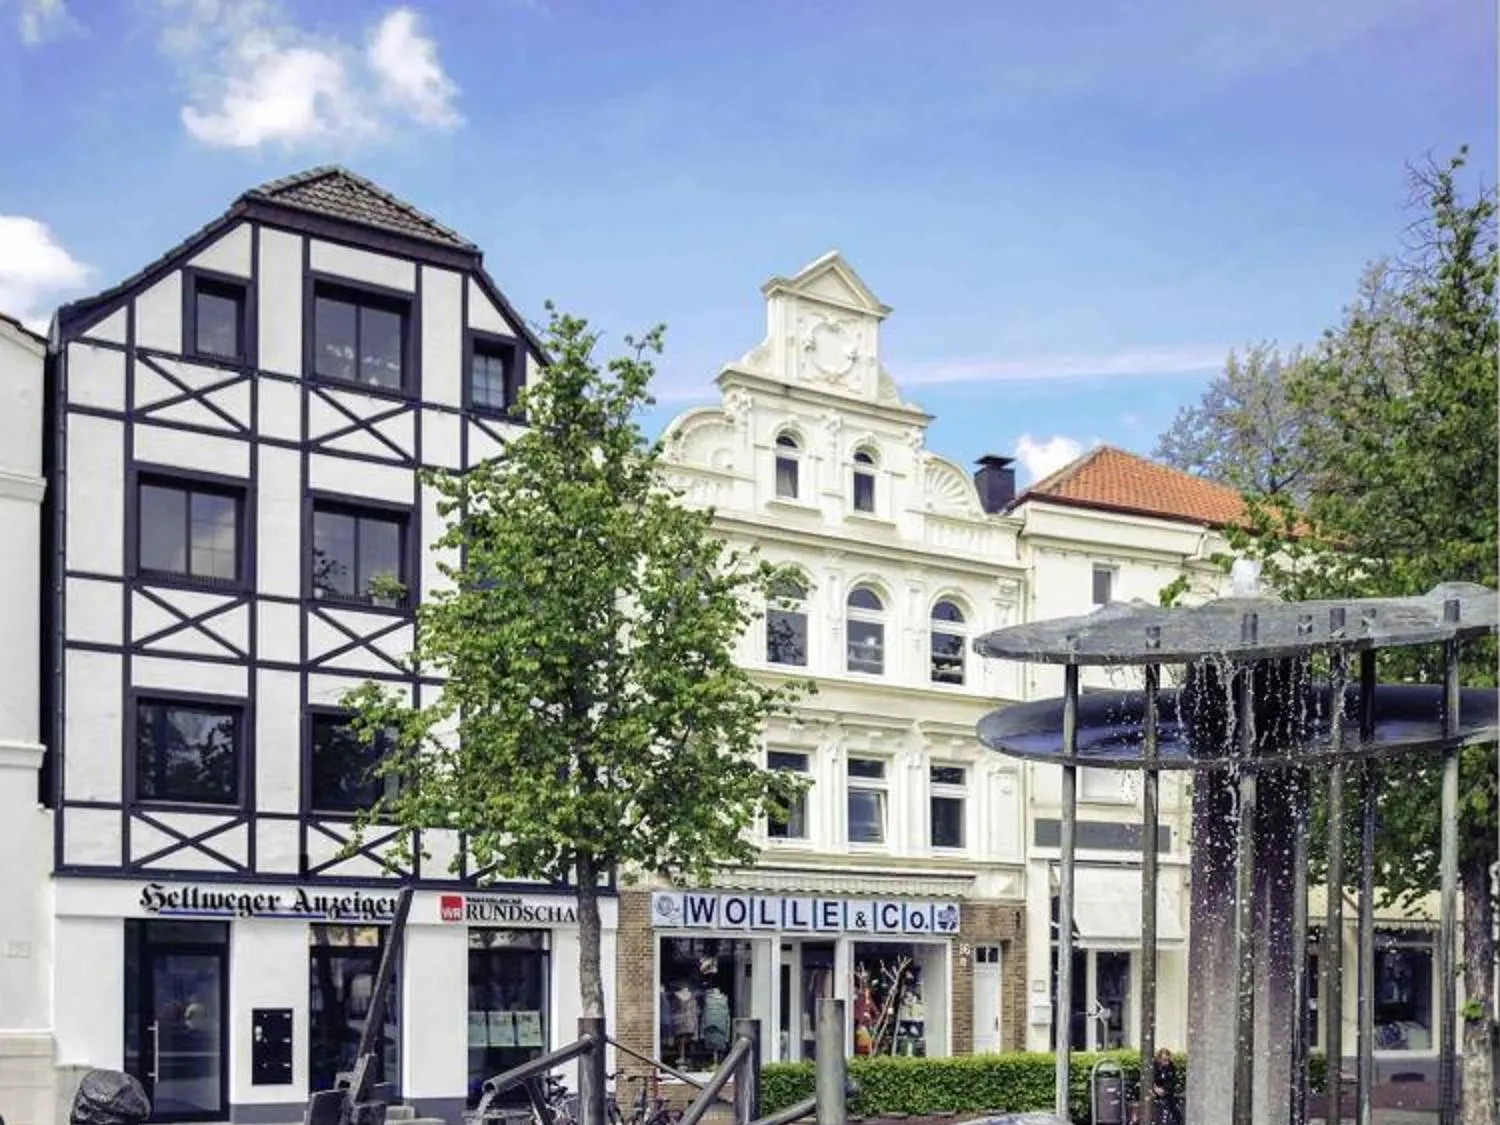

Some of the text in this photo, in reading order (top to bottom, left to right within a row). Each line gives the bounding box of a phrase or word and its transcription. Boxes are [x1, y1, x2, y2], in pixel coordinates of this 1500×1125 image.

[139, 883, 281, 917] Hellweger
[465, 903, 577, 923] RUNDSCHA
[689, 897, 930, 930] WOLLE & Co.
